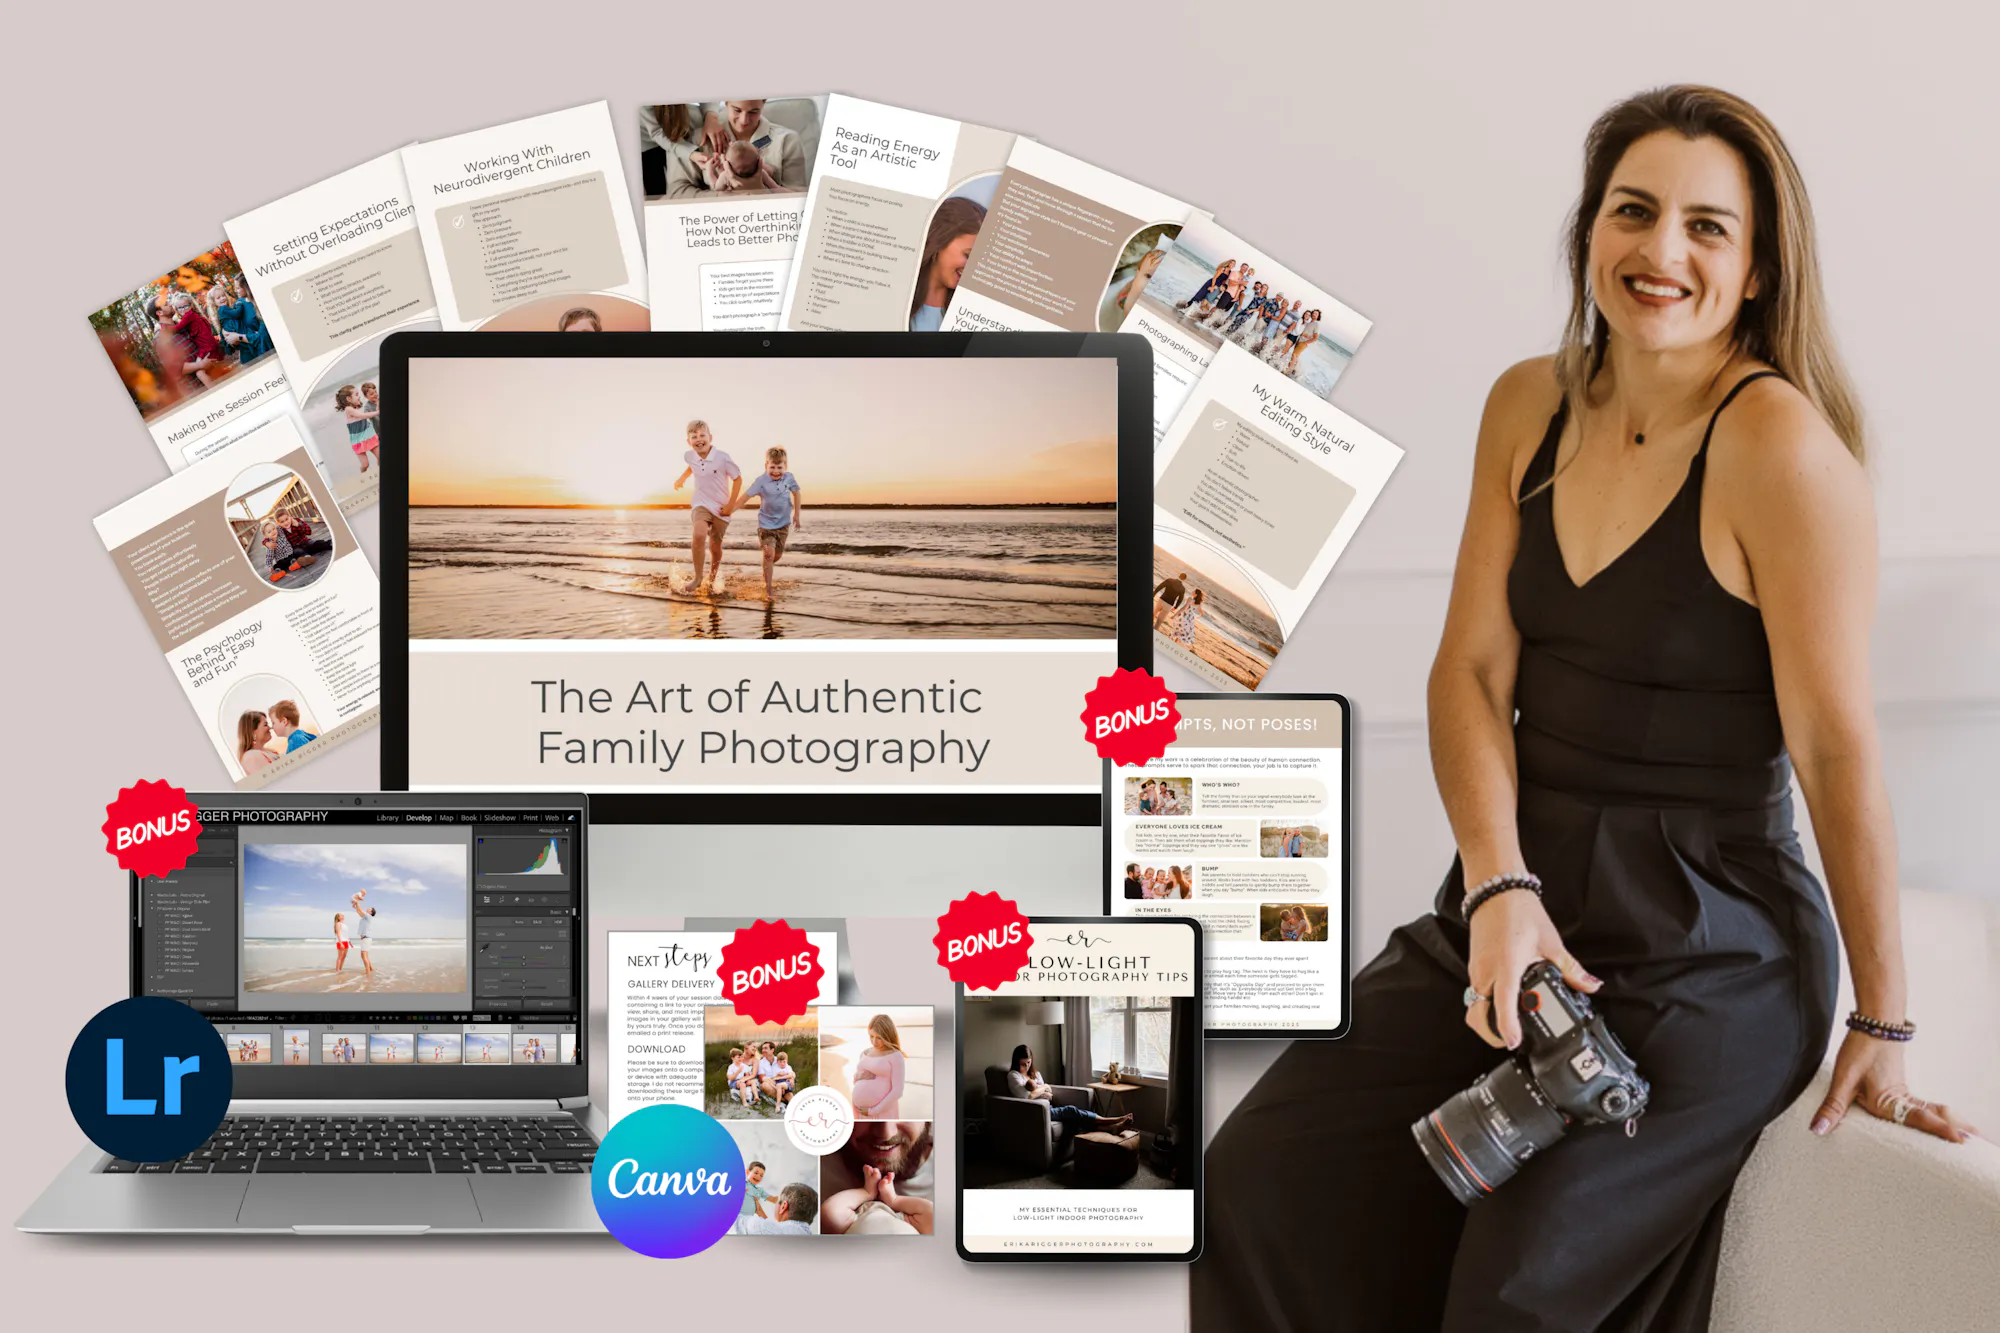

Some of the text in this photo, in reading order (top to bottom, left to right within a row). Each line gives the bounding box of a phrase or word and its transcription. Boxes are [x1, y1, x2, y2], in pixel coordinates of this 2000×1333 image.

[831, 140, 917, 168] As an Artistic
[835, 126, 940, 161] Reading Energy
[433, 150, 591, 194] Neurodivergent Children
[464, 144, 554, 173] Working With
[830, 153, 857, 169] Tool
[273, 197, 399, 255] Setting Expectations
[679, 210, 798, 226] The Power of Letting
[685, 226, 713, 236] How
[715, 225, 736, 235] Not
[255, 249, 307, 277] Without
[308, 218, 383, 254] Overloading
[687, 236, 721, 247] Leads
[722, 236, 735, 246] to
[738, 234, 774, 245] Better
[1138, 319, 1199, 362] Photographing
[167, 419, 207, 444] Making
[206, 409, 225, 422] the
[225, 388, 264, 412] Session
[263, 373, 288, 391] Feel
[1252, 383, 1356, 454] My Warm, Natural
[1260, 404, 1332, 455] Editing Style
[180, 619, 263, 668] The Psychology
[186, 651, 226, 678] Behind
[192, 670, 214, 688] and
[531, 679, 981, 713] The Art of Authentic
[1222, 718, 1256, 731] NOT
[1261, 718, 1318, 731] POSES!
[540, 729, 990, 772] Family Photography
[232, 811, 329, 822] PHOTOGRAPHY
[376, 815, 399, 823] Library
[406, 815, 432, 823] Develop
[439, 815, 454, 823] Map
[627, 943, 712, 972] NEXT steps
[1029, 956, 1151, 969] LOW-LIGHT
[627, 980, 715, 988] GALLERY DELIVERY
[1038, 972, 1149, 982] PHOTOGRAPHY
[1156, 972, 1189, 982] TIPS
[627, 1045, 686, 1053] DOWNLOAD
